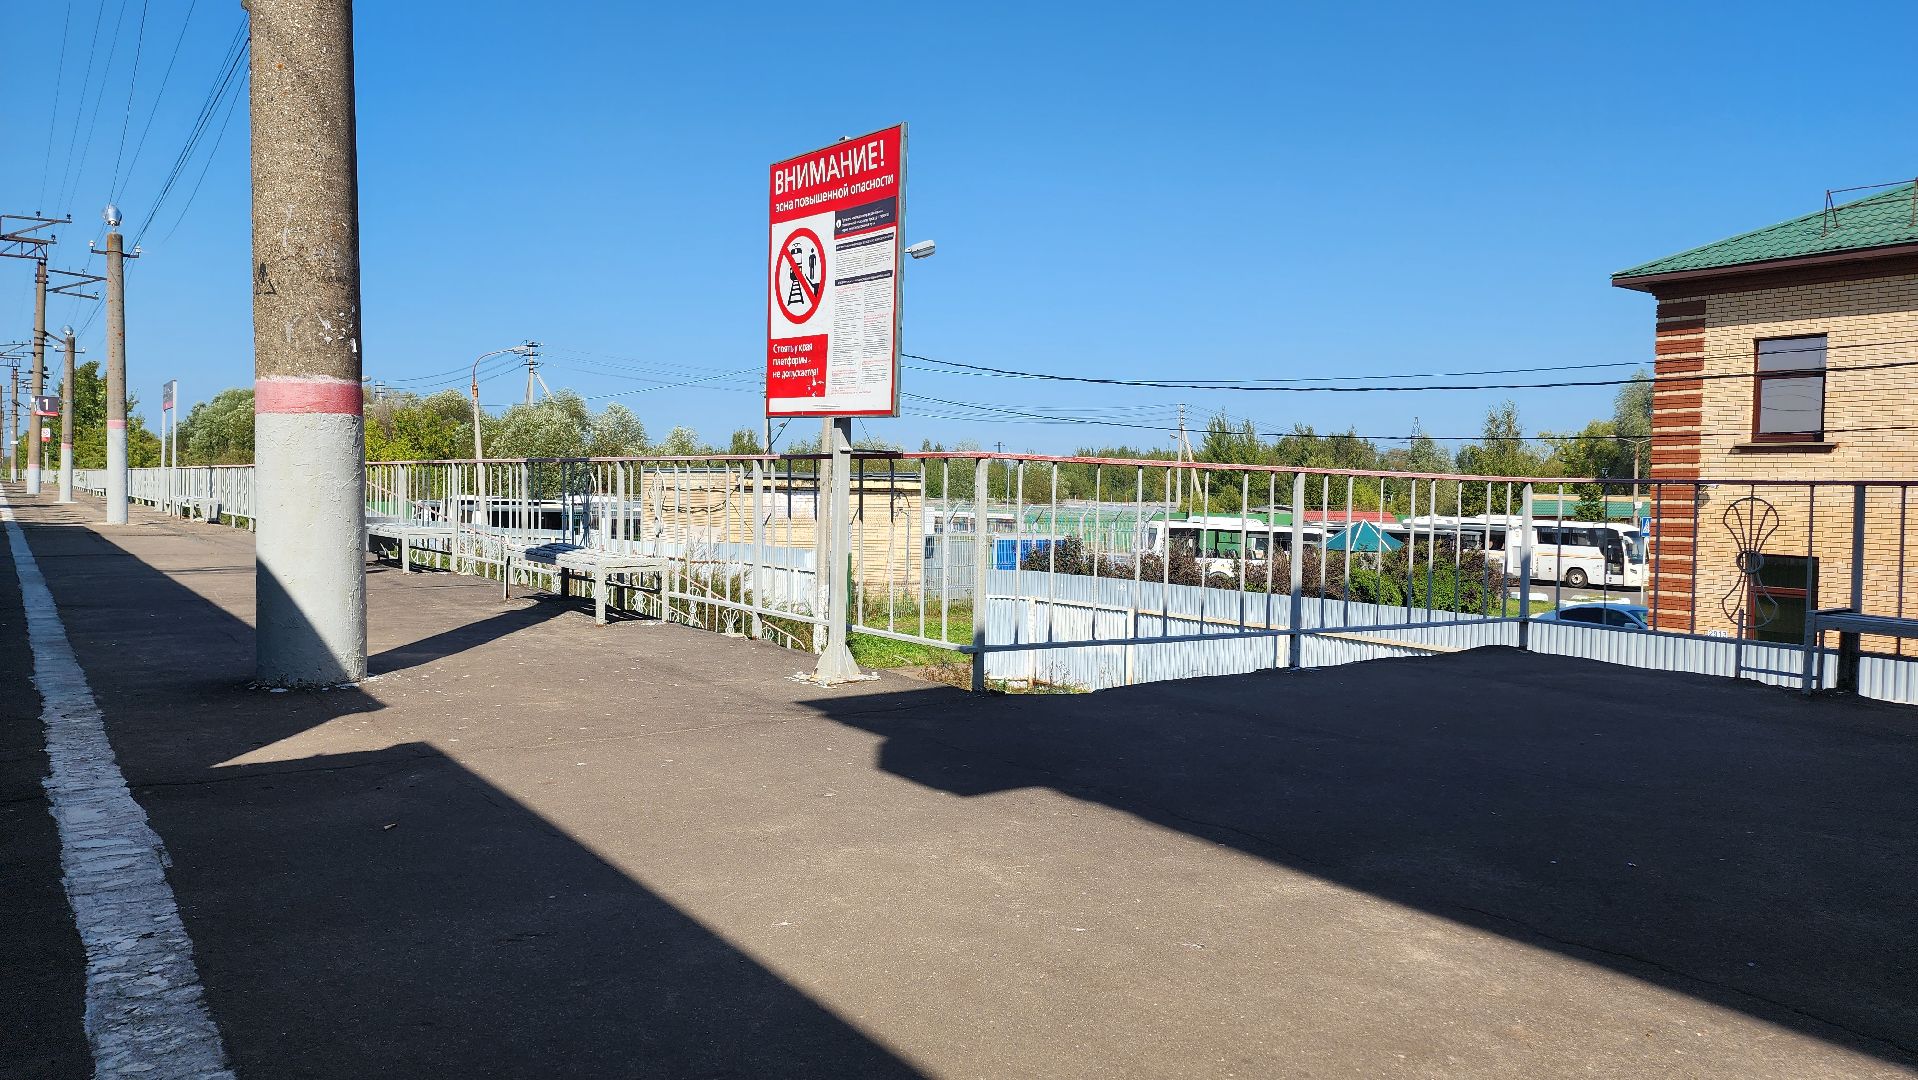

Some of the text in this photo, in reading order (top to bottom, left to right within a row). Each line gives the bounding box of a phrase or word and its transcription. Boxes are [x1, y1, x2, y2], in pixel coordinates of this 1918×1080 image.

[775, 139, 885, 195] ВНИМАНИЕ!
[775, 174, 894, 213] зона повышенной опасности
[772, 344, 794, 354] Стоять
[799, 342, 813, 353] края
[772, 355, 808, 368] платформы
[772, 370, 781, 379] не
[43, 399, 49, 410] 1
